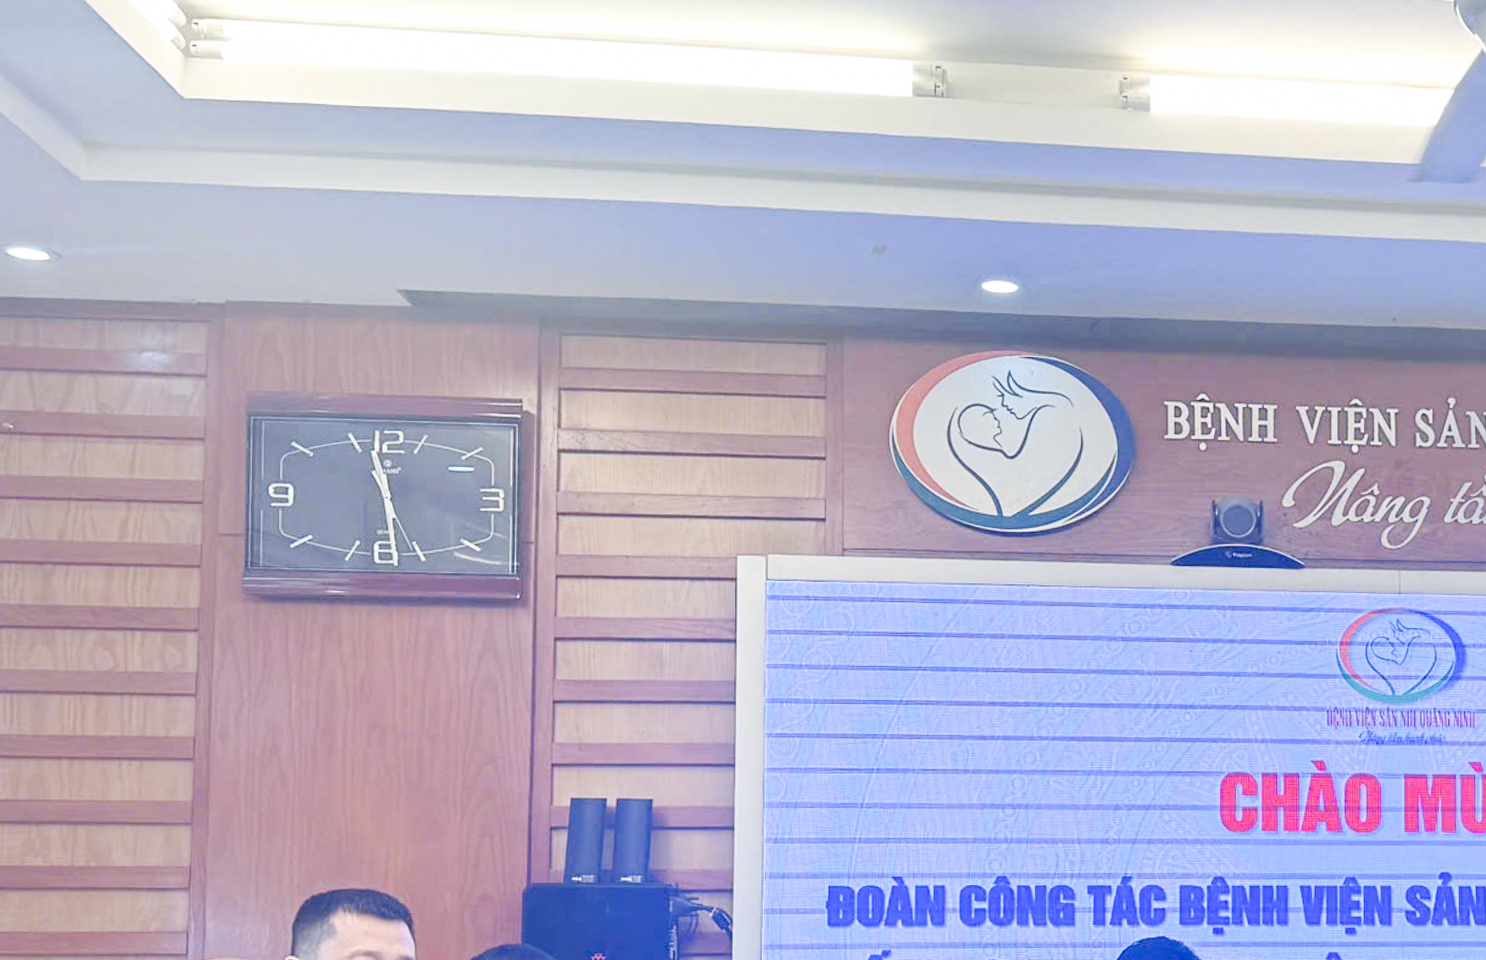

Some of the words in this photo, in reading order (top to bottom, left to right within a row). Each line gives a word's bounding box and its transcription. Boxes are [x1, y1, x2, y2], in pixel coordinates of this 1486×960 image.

[373, 430, 405, 454] 12
[1164, 393, 1278, 451] BỆNH
[1295, 399, 1399, 454] VIỆN
[268, 483, 294, 506] 9
[480, 488, 505, 512] 3
[1282, 460, 1431, 549] Nâng
[1220, 760, 1382, 834] CHÀO
[826, 877, 946, 927] ĐOÀN
[959, 876, 1076, 927] CÔNG
[1088, 877, 1166, 927] TÁC
[1179, 877, 1289, 935] BỆNH
[1300, 877, 1392, 935] VIỆN
